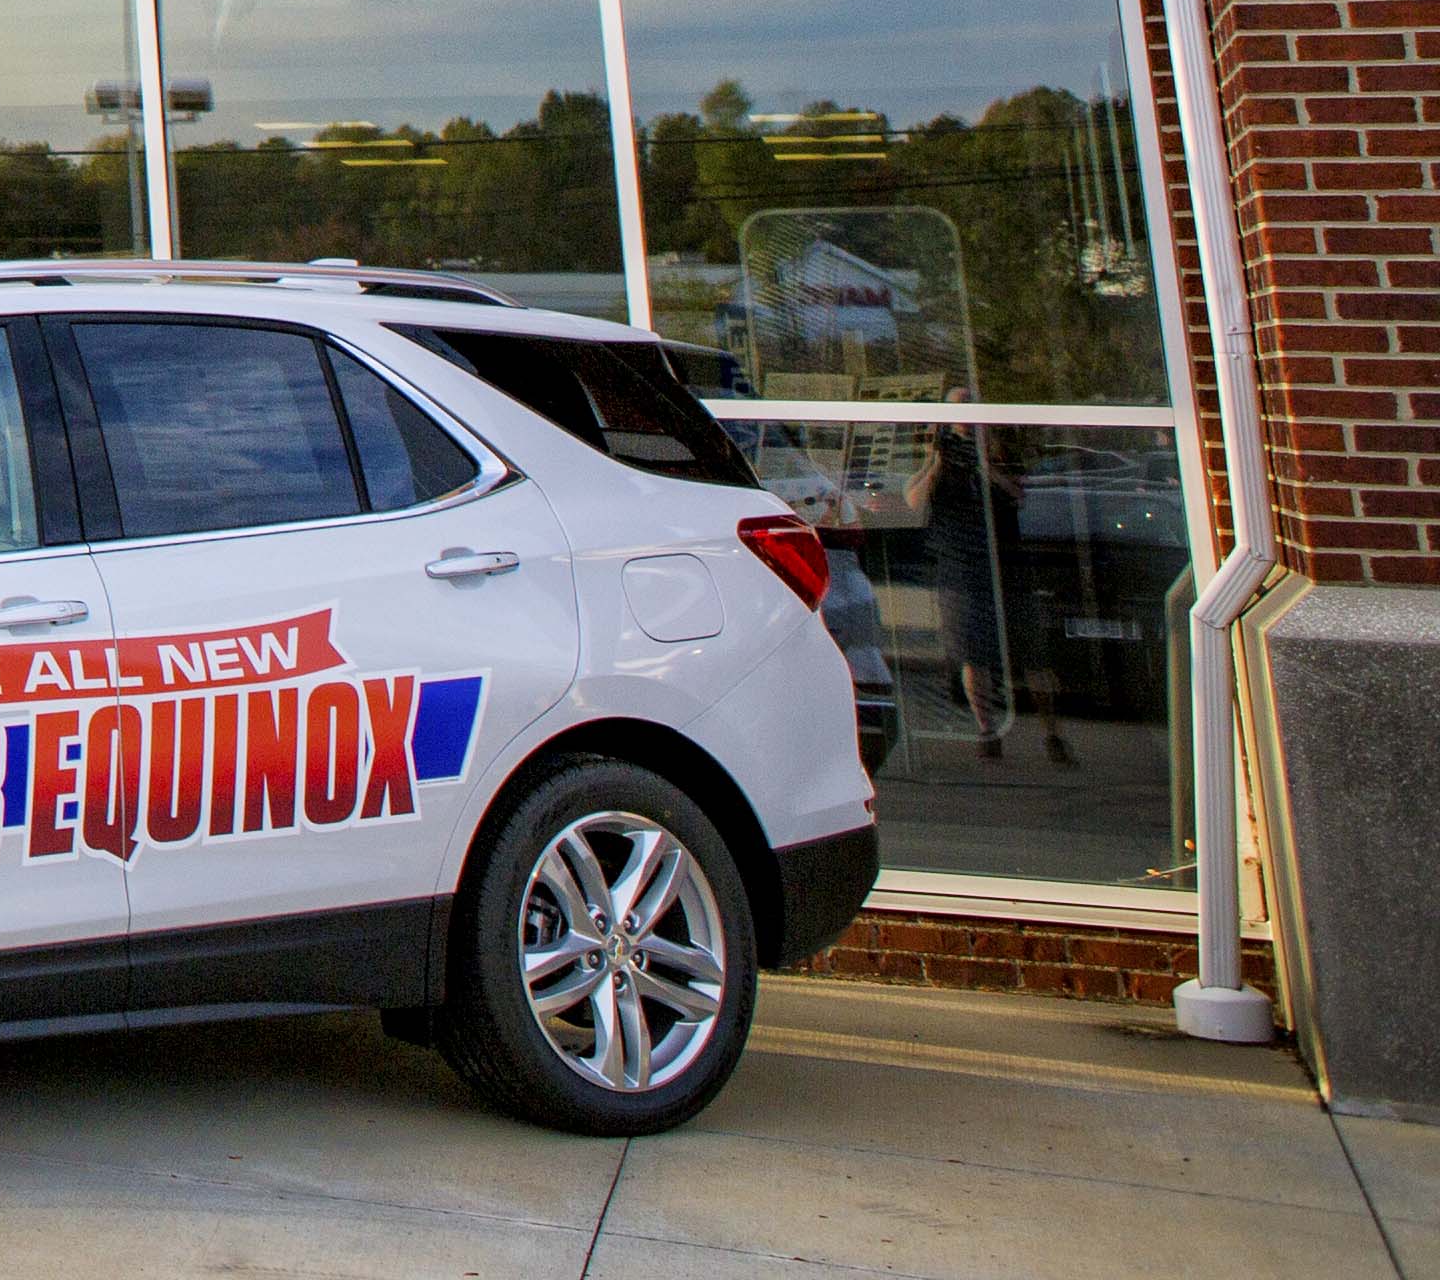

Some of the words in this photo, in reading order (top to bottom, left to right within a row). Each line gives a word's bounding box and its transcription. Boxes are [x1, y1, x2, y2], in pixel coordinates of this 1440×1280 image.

[22, 646, 143, 694] ALL
[157, 627, 300, 685] NEW
[27, 675, 416, 863] EQUINOX
